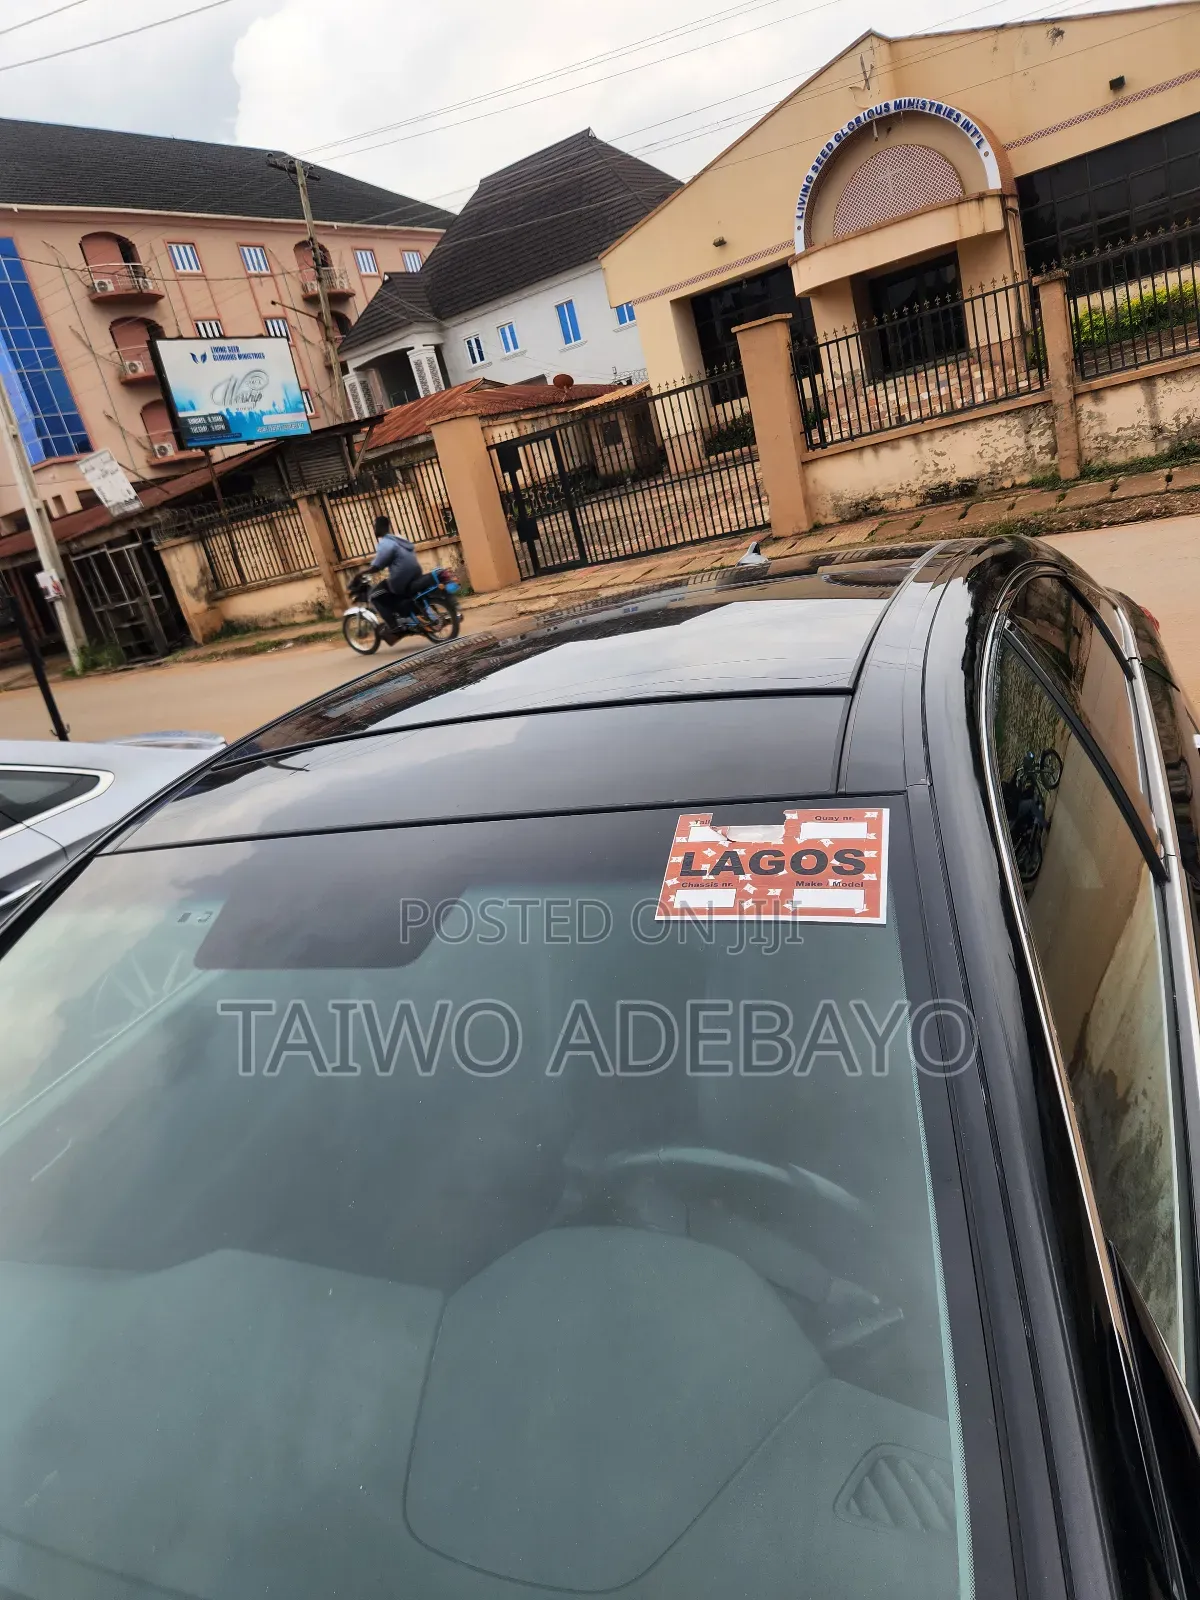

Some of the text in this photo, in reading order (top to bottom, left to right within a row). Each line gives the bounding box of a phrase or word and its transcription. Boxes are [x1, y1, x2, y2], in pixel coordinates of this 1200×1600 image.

[796, 98, 985, 219] LIVING SEED GLORIOUS MINISTRIES INT'L
[679, 848, 866, 877] LAGOS
[832, 880, 864, 888] Model
